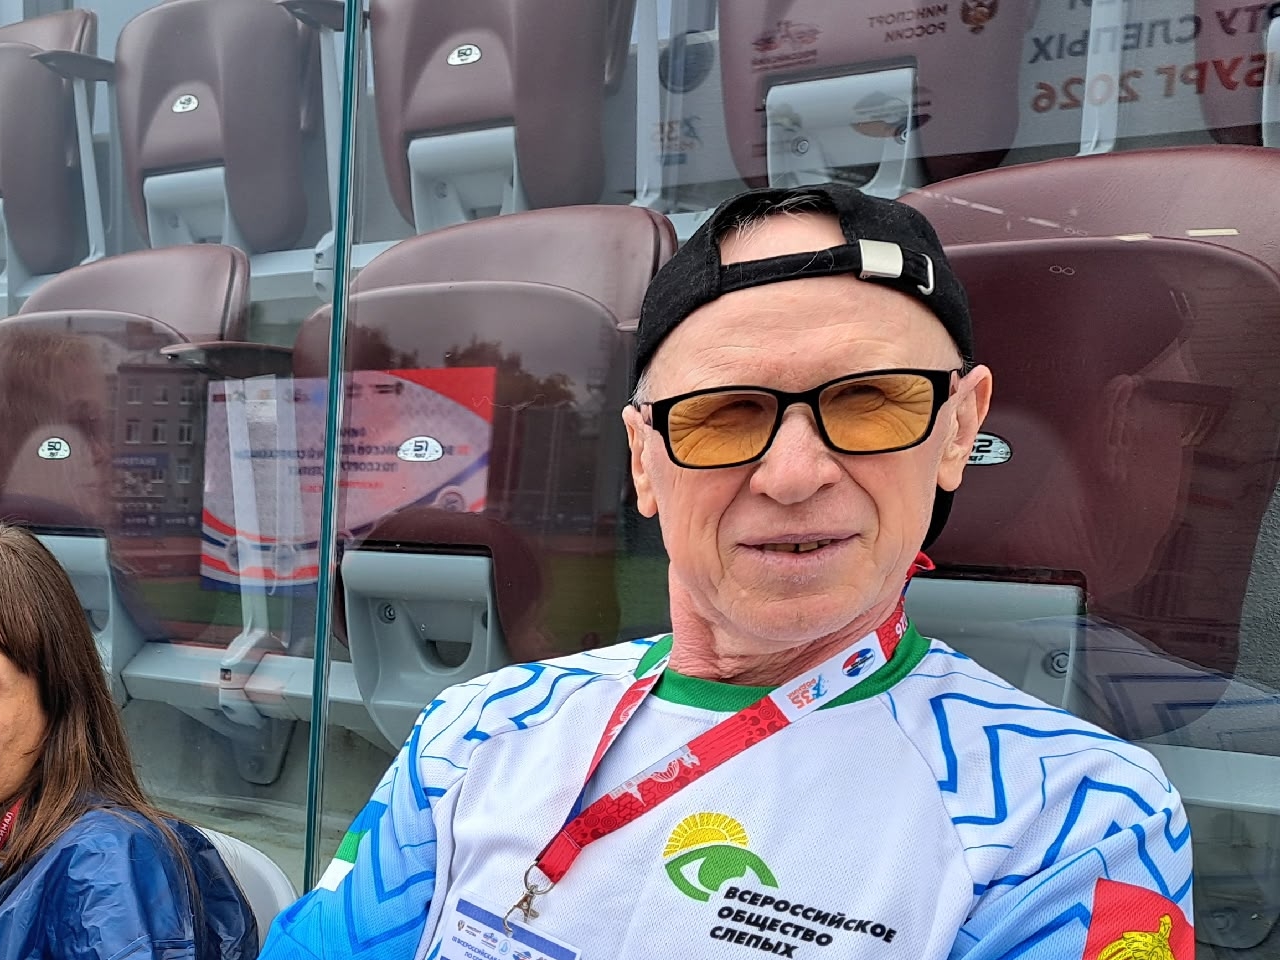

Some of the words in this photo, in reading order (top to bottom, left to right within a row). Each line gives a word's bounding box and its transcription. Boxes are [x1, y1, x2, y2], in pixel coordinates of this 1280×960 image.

[47, 441, 62, 451] 50
[717, 906, 834, 947] ОБЩЕСТВО
[723, 886, 897, 944] ВСЕРОССИЙСКОЕ
[709, 925, 800, 959] СЛЕПЫХ
